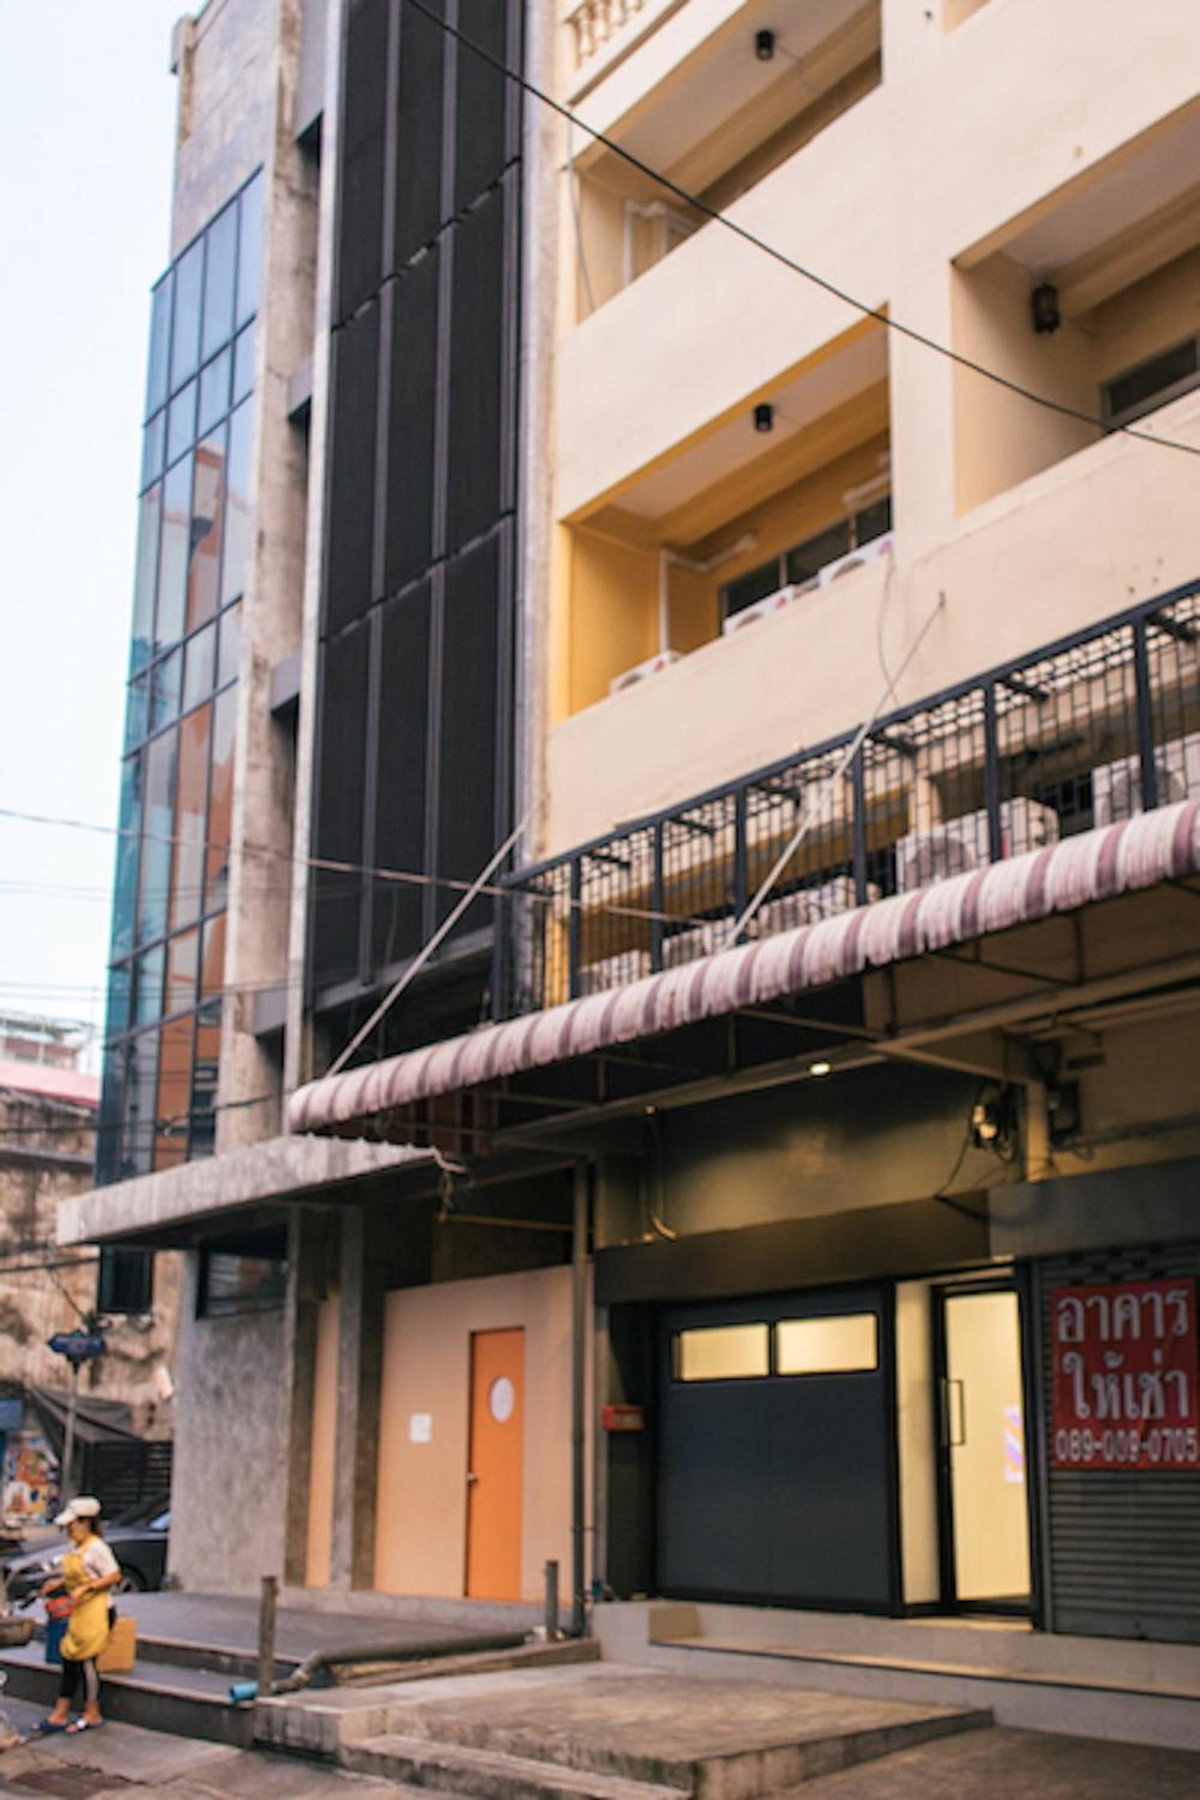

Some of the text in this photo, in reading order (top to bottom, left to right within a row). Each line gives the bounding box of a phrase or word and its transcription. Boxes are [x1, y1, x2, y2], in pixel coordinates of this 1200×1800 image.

[1058, 1289, 1188, 1342] อาคาร
[1062, 1350, 1189, 1420] ให้เช่า
